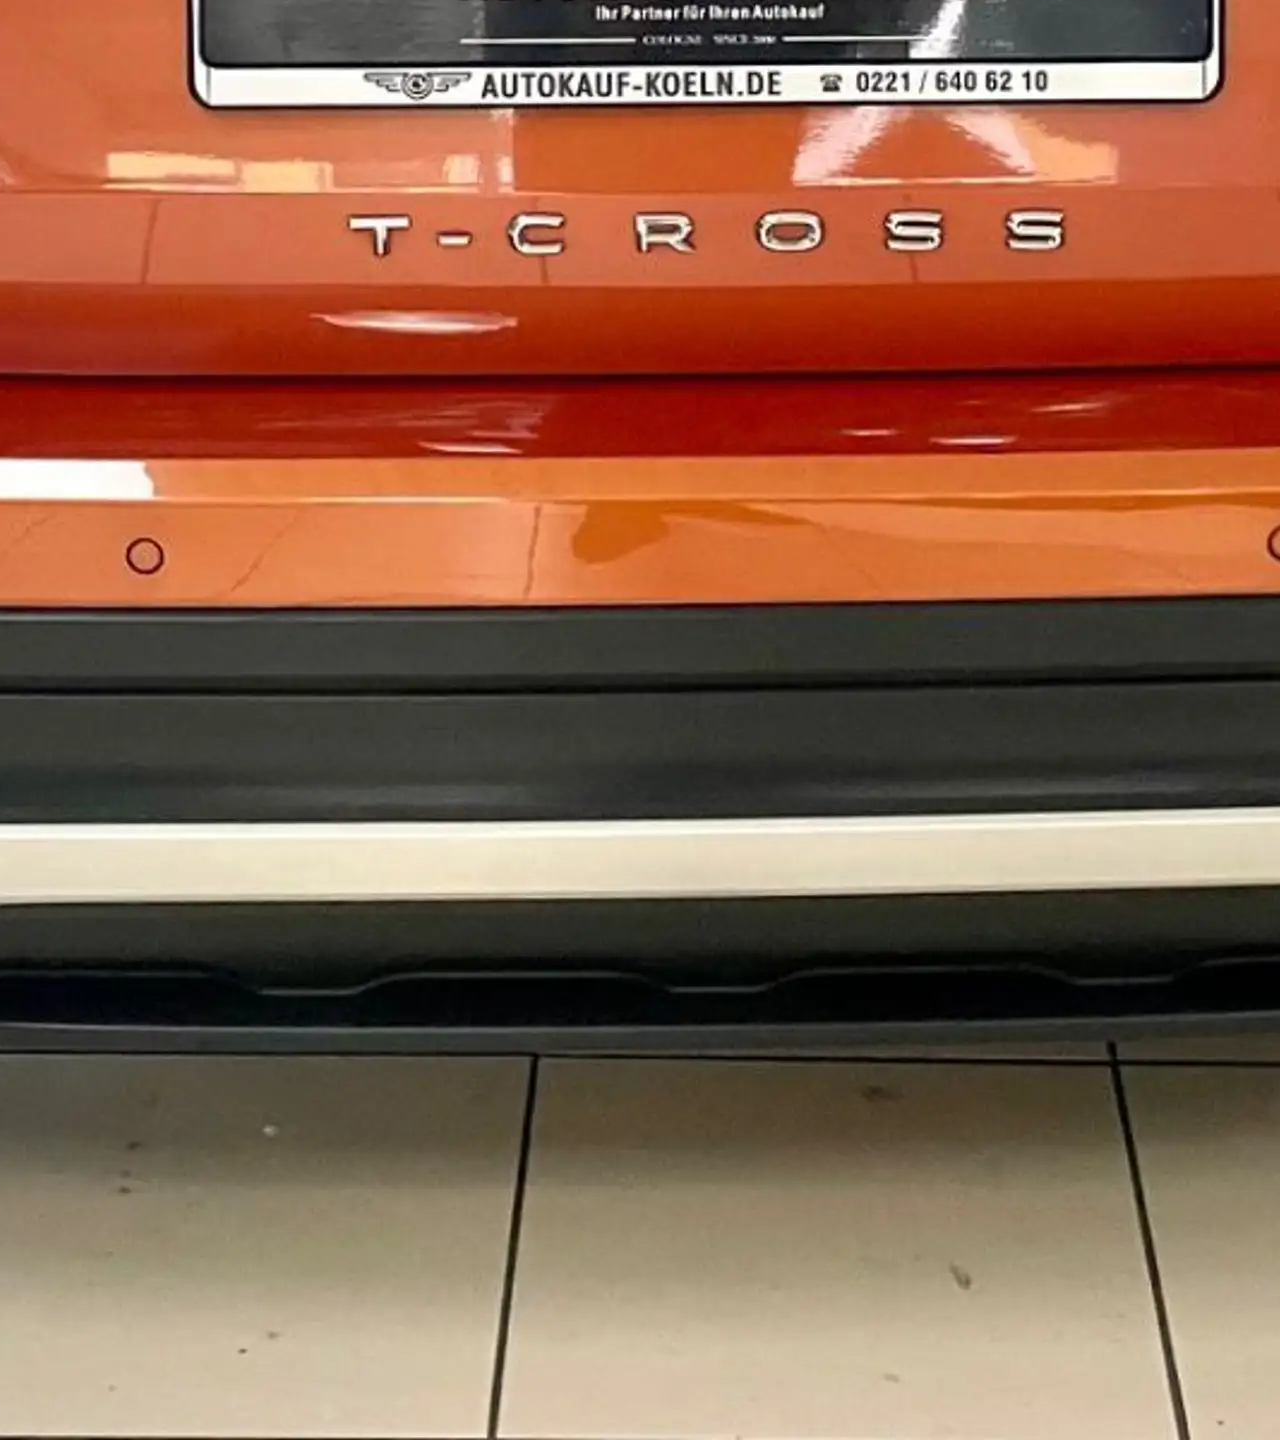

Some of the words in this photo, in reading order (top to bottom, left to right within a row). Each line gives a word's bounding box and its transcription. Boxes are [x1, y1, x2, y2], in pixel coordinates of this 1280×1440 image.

[595, 4, 618, 21] Ihr
[621, 4, 680, 21] Partner
[683, 4, 706, 21] für
[708, 4, 750, 21] Ihren
[753, 2, 825, 20] Autokauf
[480, 71, 783, 99] AUTOKAUF-KOELN.DE
[855, 70, 911, 93] 0221
[917, 70, 929, 94] /
[934, 70, 977, 93] 640
[984, 70, 1013, 93] 62
[1021, 70, 1049, 92] 10
[348, 210, 1066, 255] T-CROSS
